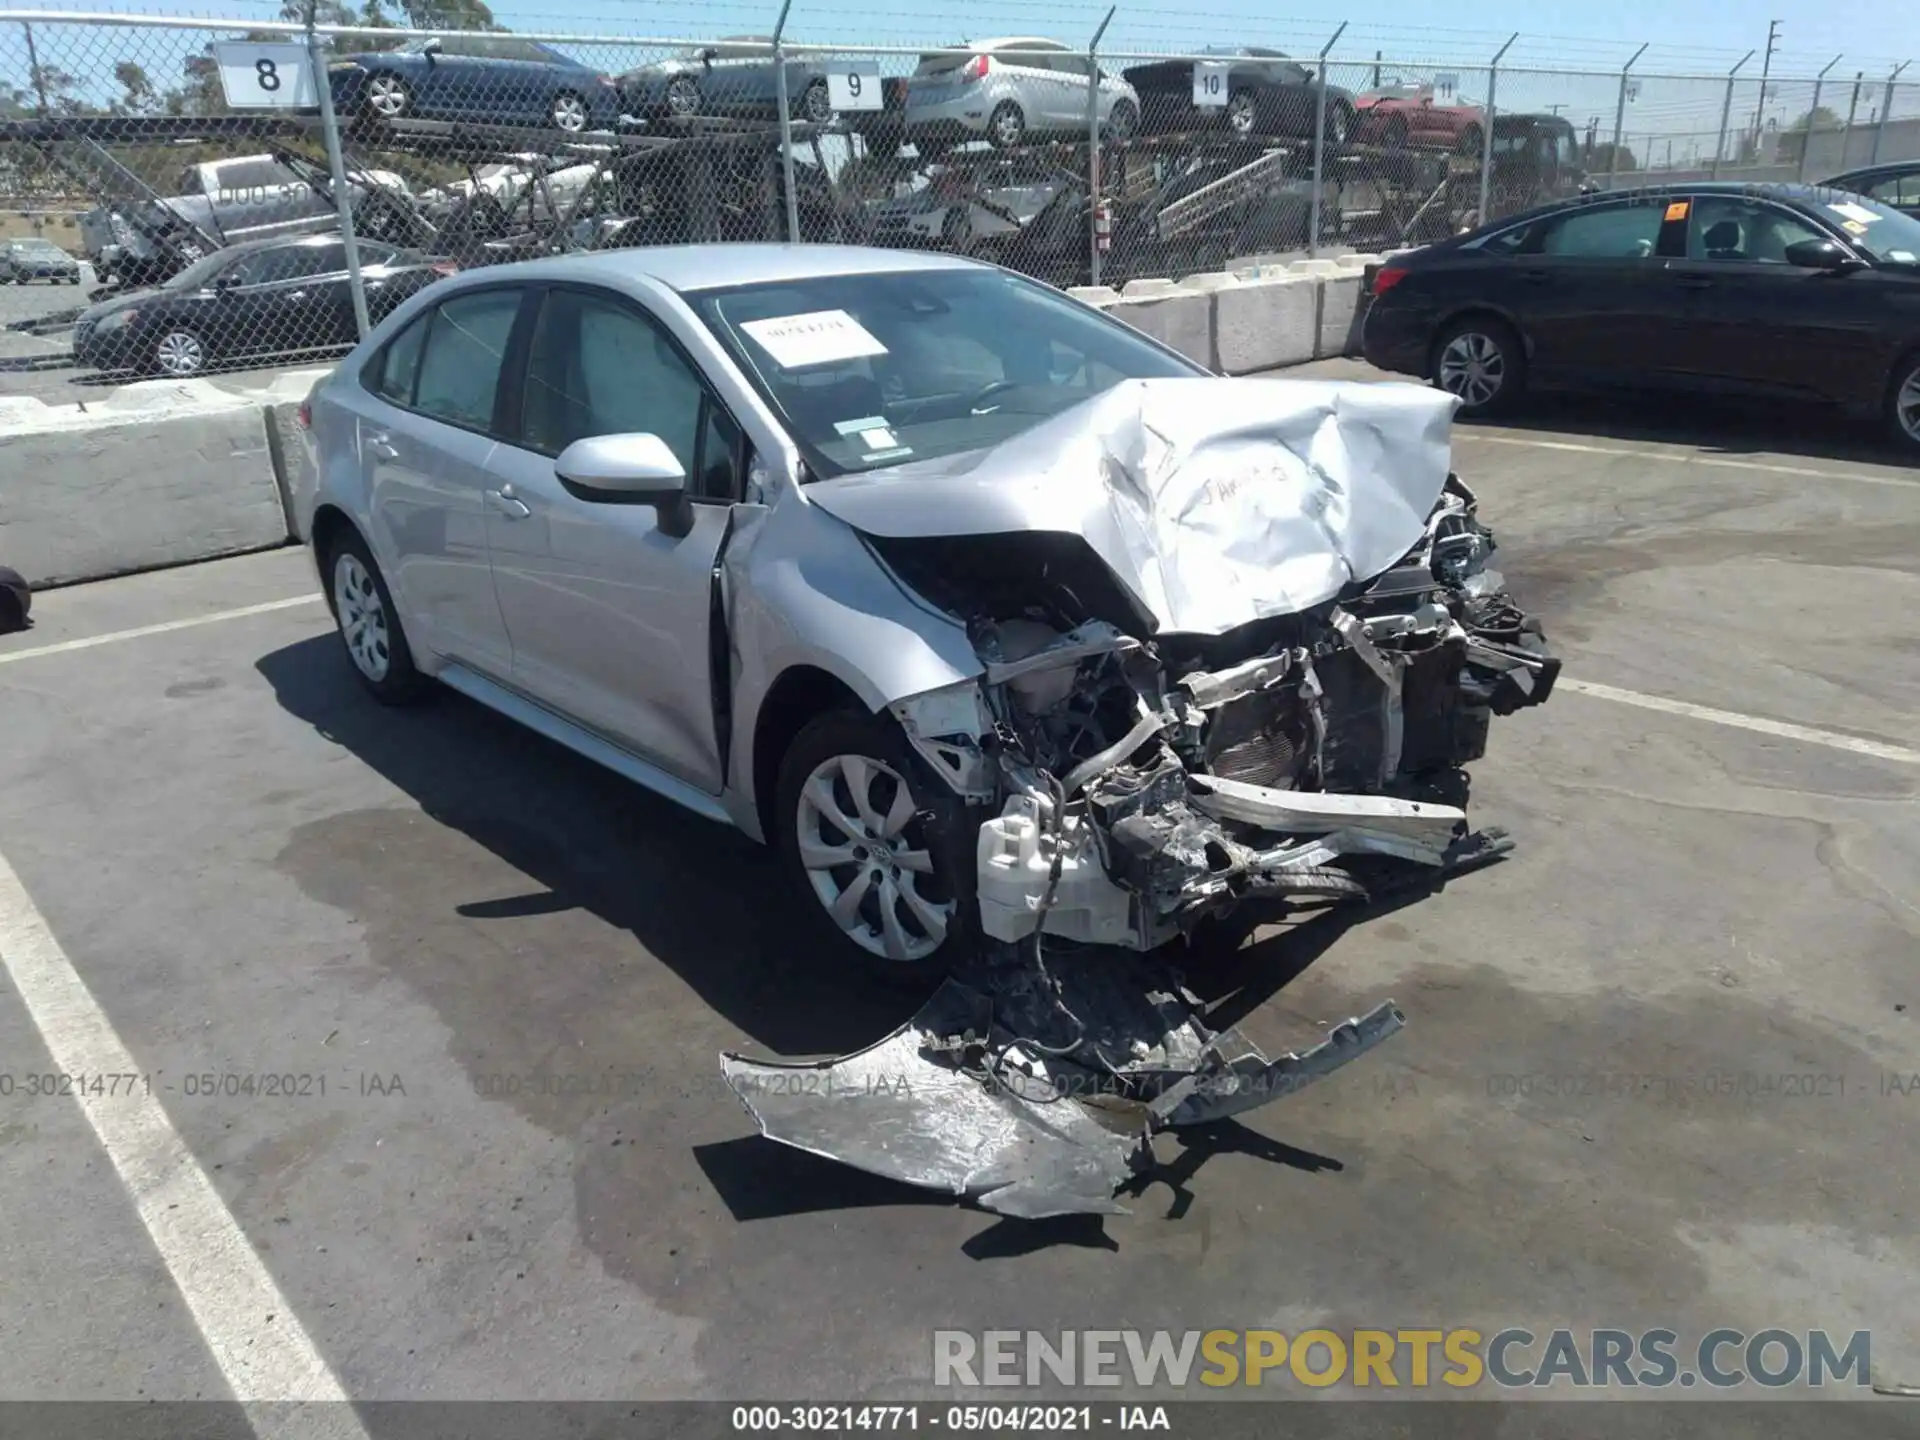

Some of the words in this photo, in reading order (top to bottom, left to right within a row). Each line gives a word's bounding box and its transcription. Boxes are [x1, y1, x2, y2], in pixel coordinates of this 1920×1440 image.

[256, 58, 281, 91] 8
[847, 72, 862, 97] 9
[1203, 73, 1220, 95] 10
[1440, 81, 1452, 98] 11
